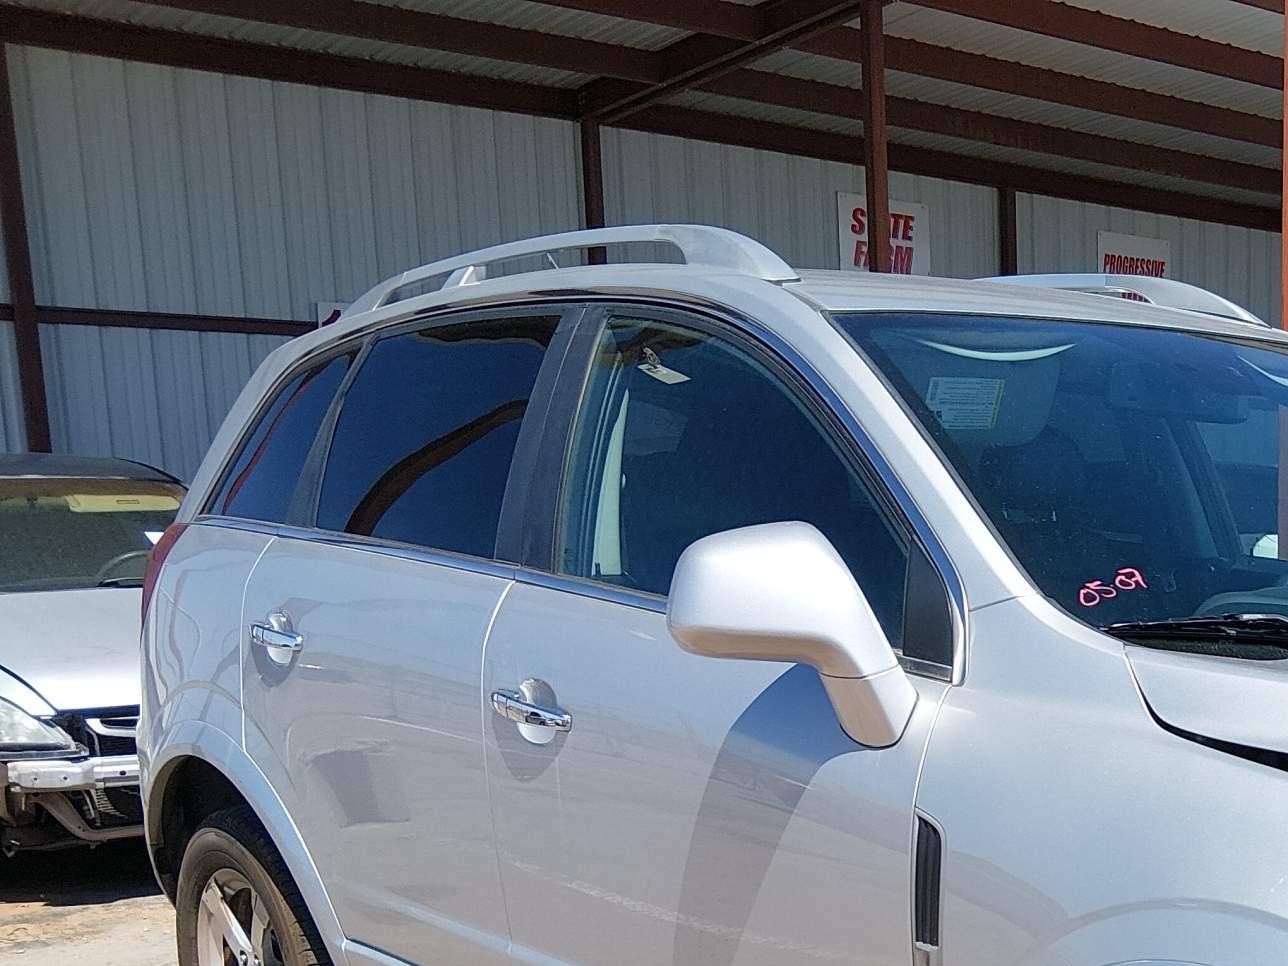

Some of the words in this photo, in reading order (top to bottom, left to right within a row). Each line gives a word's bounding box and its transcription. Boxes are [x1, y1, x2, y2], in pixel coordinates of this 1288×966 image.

[850, 207, 915, 241] STE
[853, 240, 914, 275] FM
[1103, 253, 1166, 278] PROGRESSIVE
